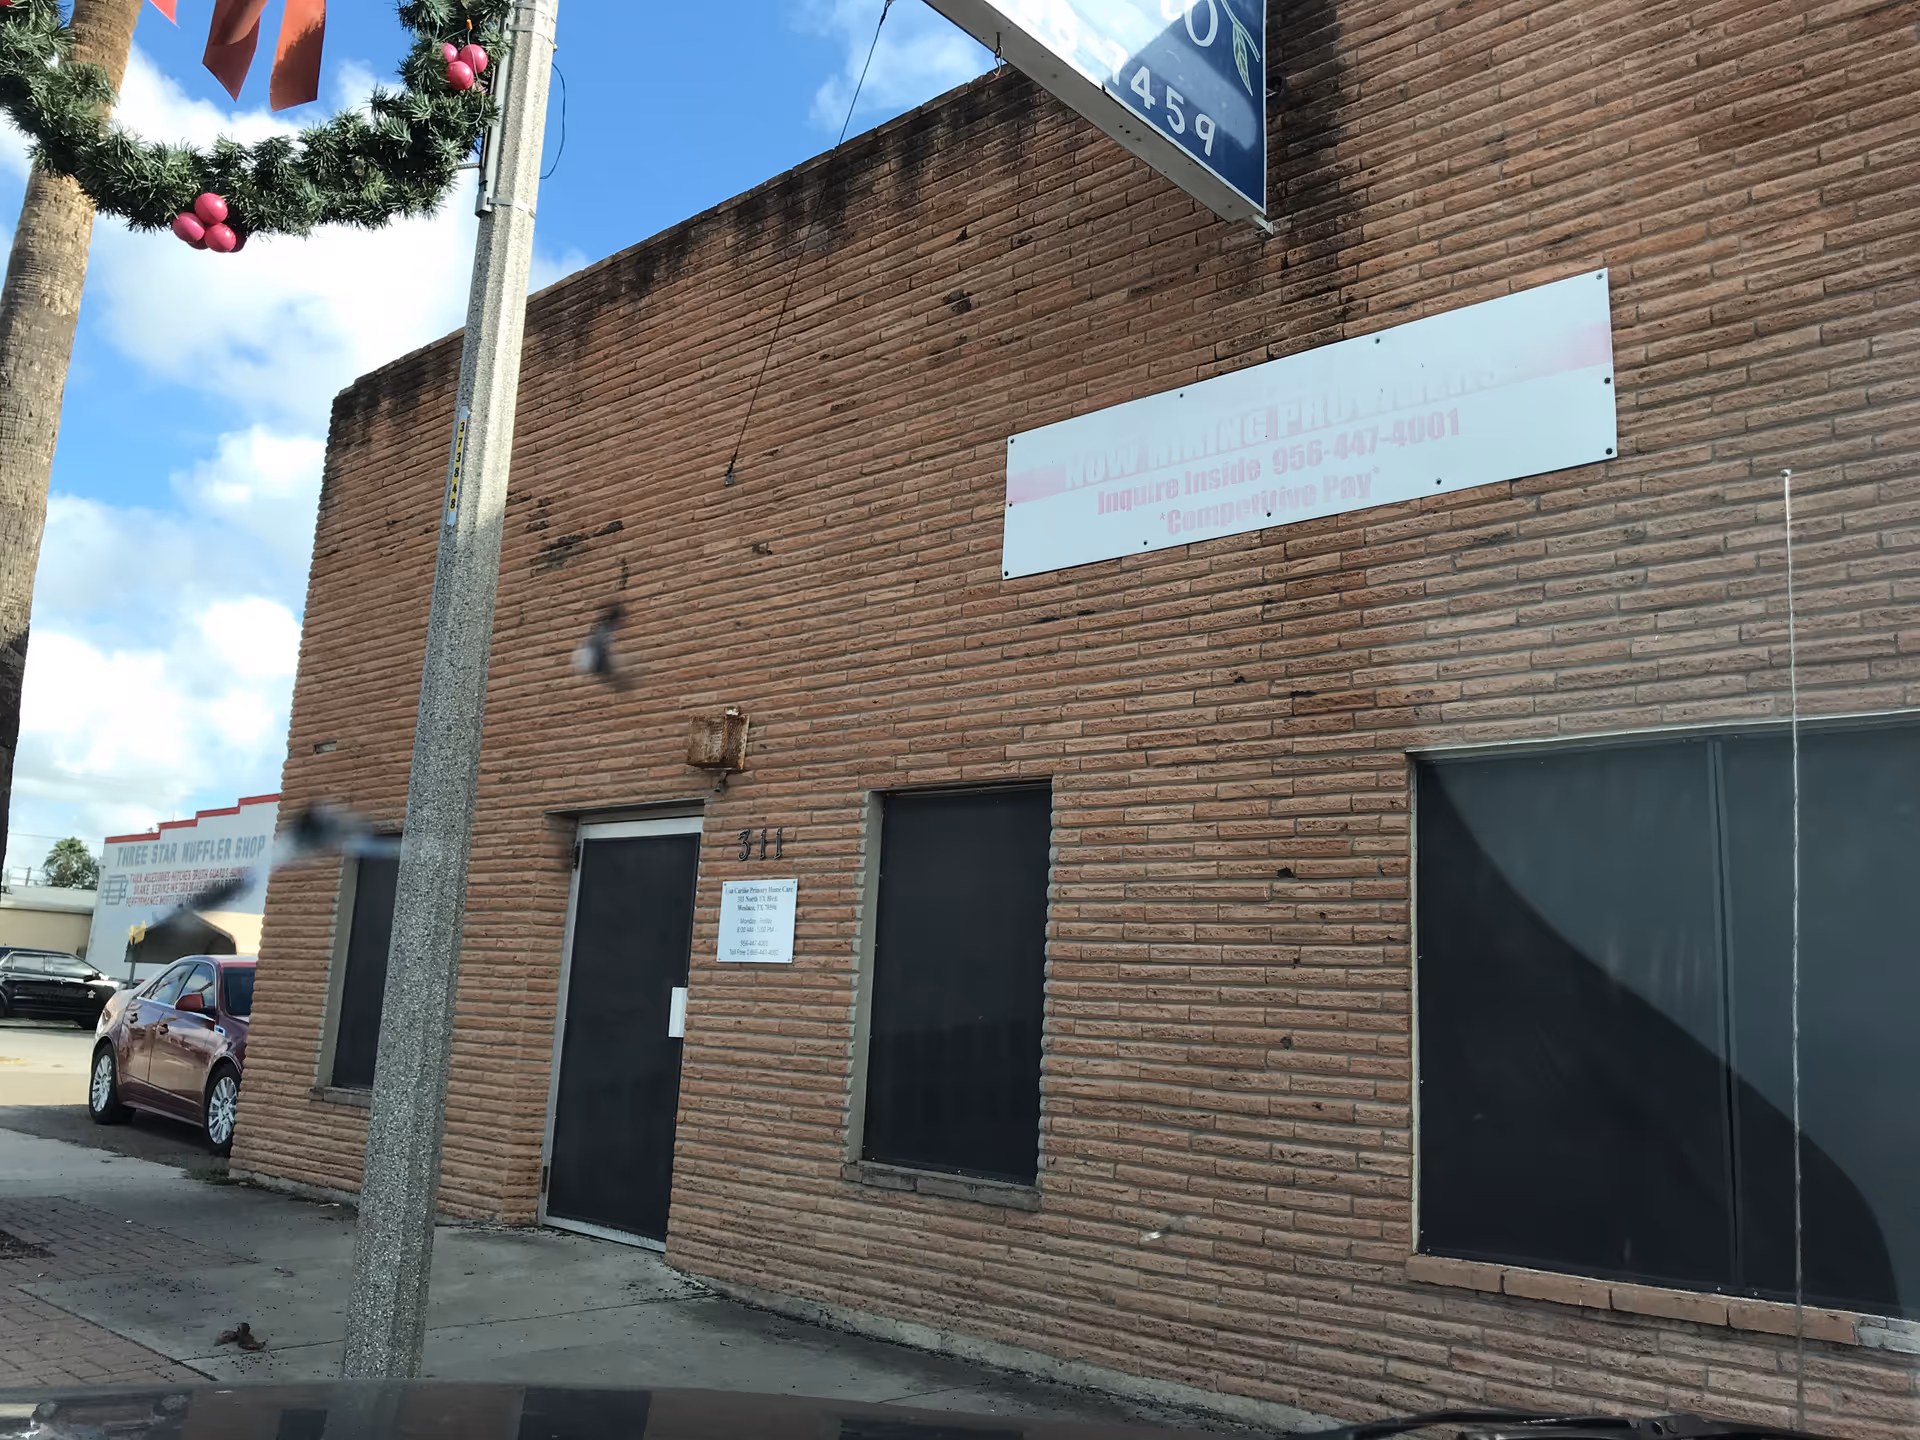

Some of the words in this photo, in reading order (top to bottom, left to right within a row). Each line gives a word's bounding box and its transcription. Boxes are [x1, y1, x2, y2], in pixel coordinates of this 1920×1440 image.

[450, 421, 465, 509] 373848
[1097, 476, 1180, 516] Inquire
[1184, 457, 1262, 496] Inside
[1272, 407, 1461, 475] 956-447-4001
[117, 844, 148, 867] THREE
[151, 842, 178, 865] STAR
[181, 838, 231, 864] MUFFLER
[235, 835, 266, 859] SHOP
[737, 827, 782, 861] 311
